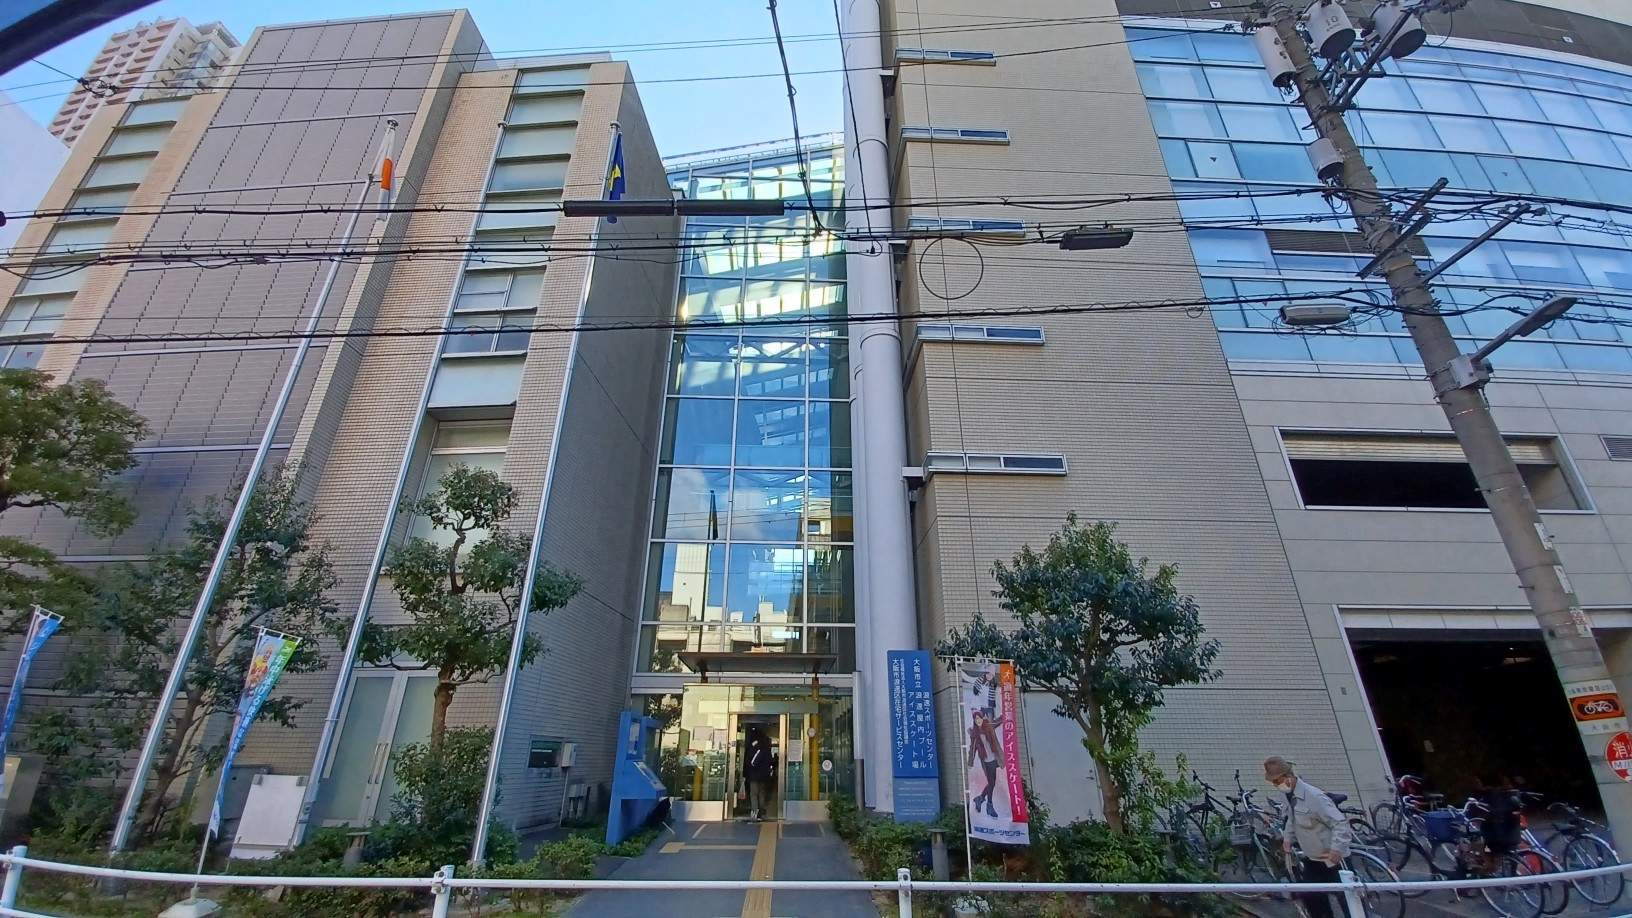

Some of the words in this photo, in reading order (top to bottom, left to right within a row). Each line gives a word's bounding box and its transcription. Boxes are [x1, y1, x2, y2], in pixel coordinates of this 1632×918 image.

[913, 658, 922, 688] 大阪市立
[908, 692, 919, 769] アイススケート場
[915, 692, 927, 769] 浪速屋内プール
[923, 692, 934, 769] 浪速スポーツセンター
